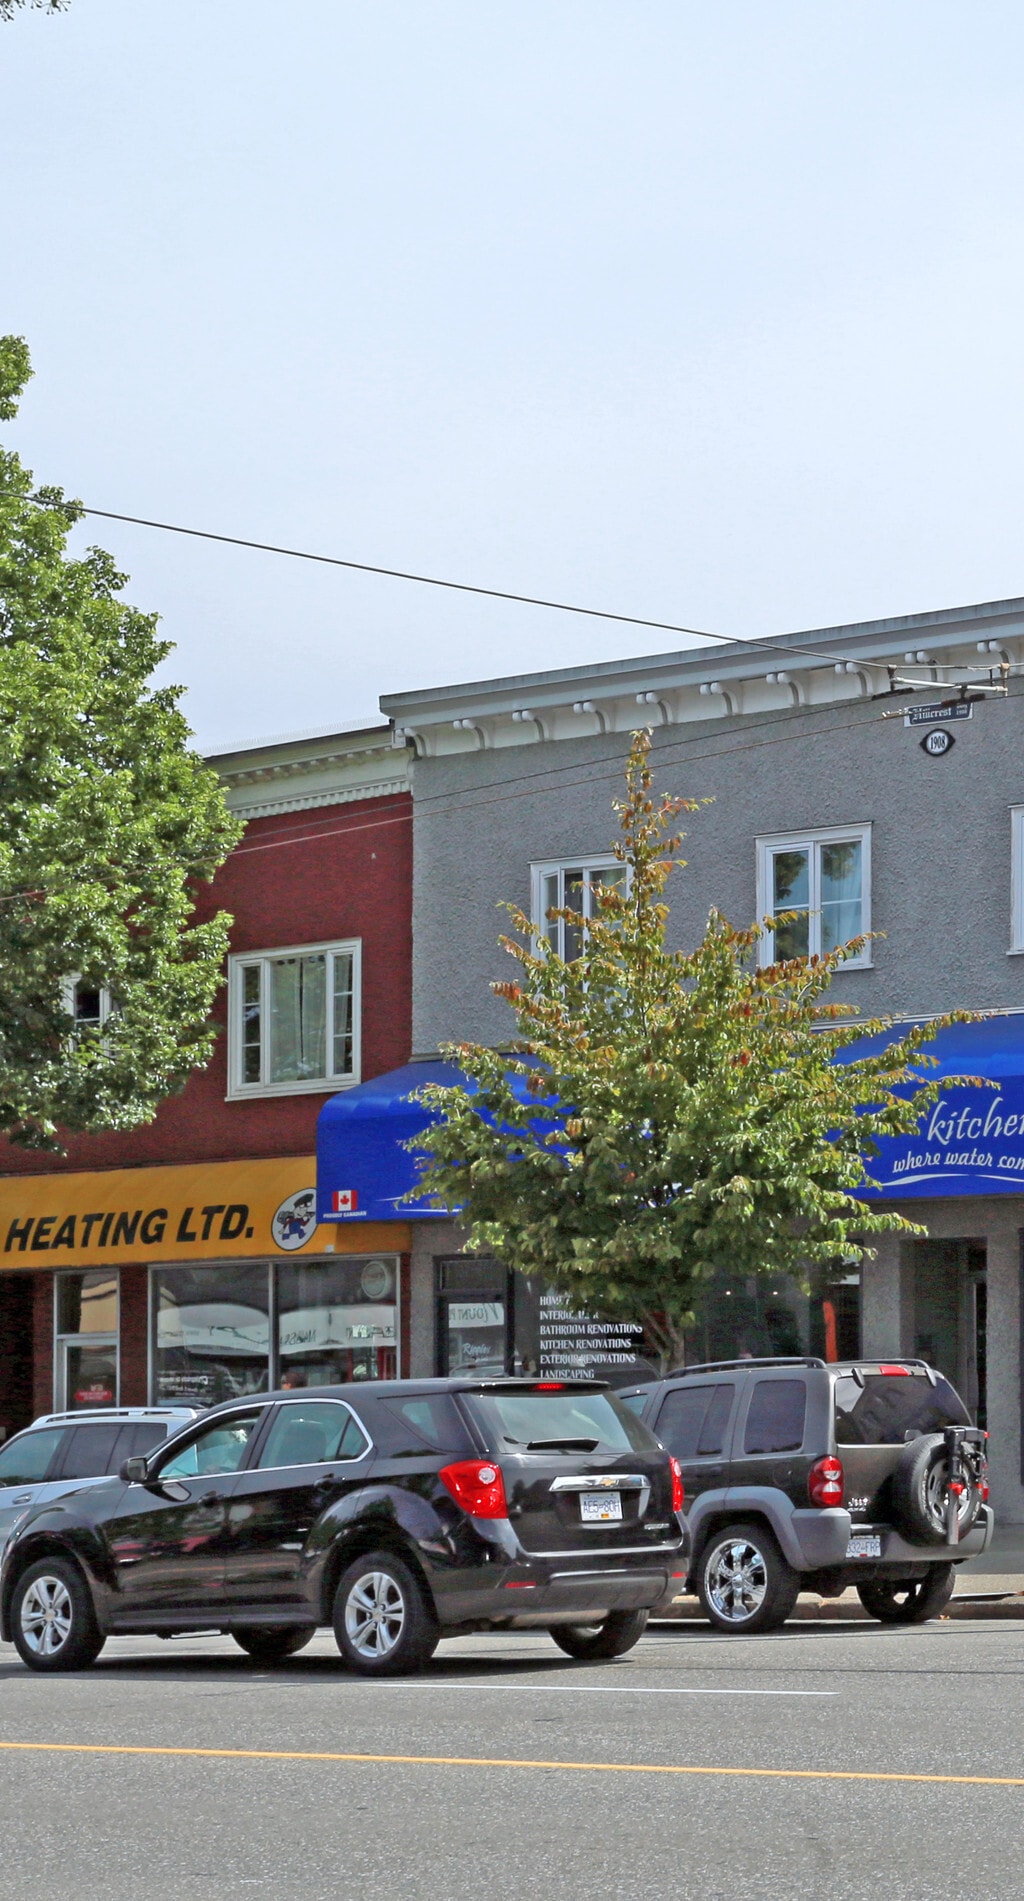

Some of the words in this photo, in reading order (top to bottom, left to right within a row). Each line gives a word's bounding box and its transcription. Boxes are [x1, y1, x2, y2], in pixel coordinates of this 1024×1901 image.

[930, 736, 946, 750] 1908
[892, 1150, 941, 1174] where
[944, 1147, 993, 1168] water
[4, 1208, 166, 1253] HEATING
[175, 1203, 255, 1243] LTD.
[540, 1324, 585, 1336] BATHROOM
[587, 1323, 643, 1335] RENOVATIONS
[540, 1339, 575, 1350] KITCHEN
[576, 1338, 632, 1350] RENOVATIONS
[540, 1354, 579, 1365] EXTERIOR
[580, 1353, 636, 1364] RENOVATIONS
[540, 1369, 595, 1379] LANDSCAPING
